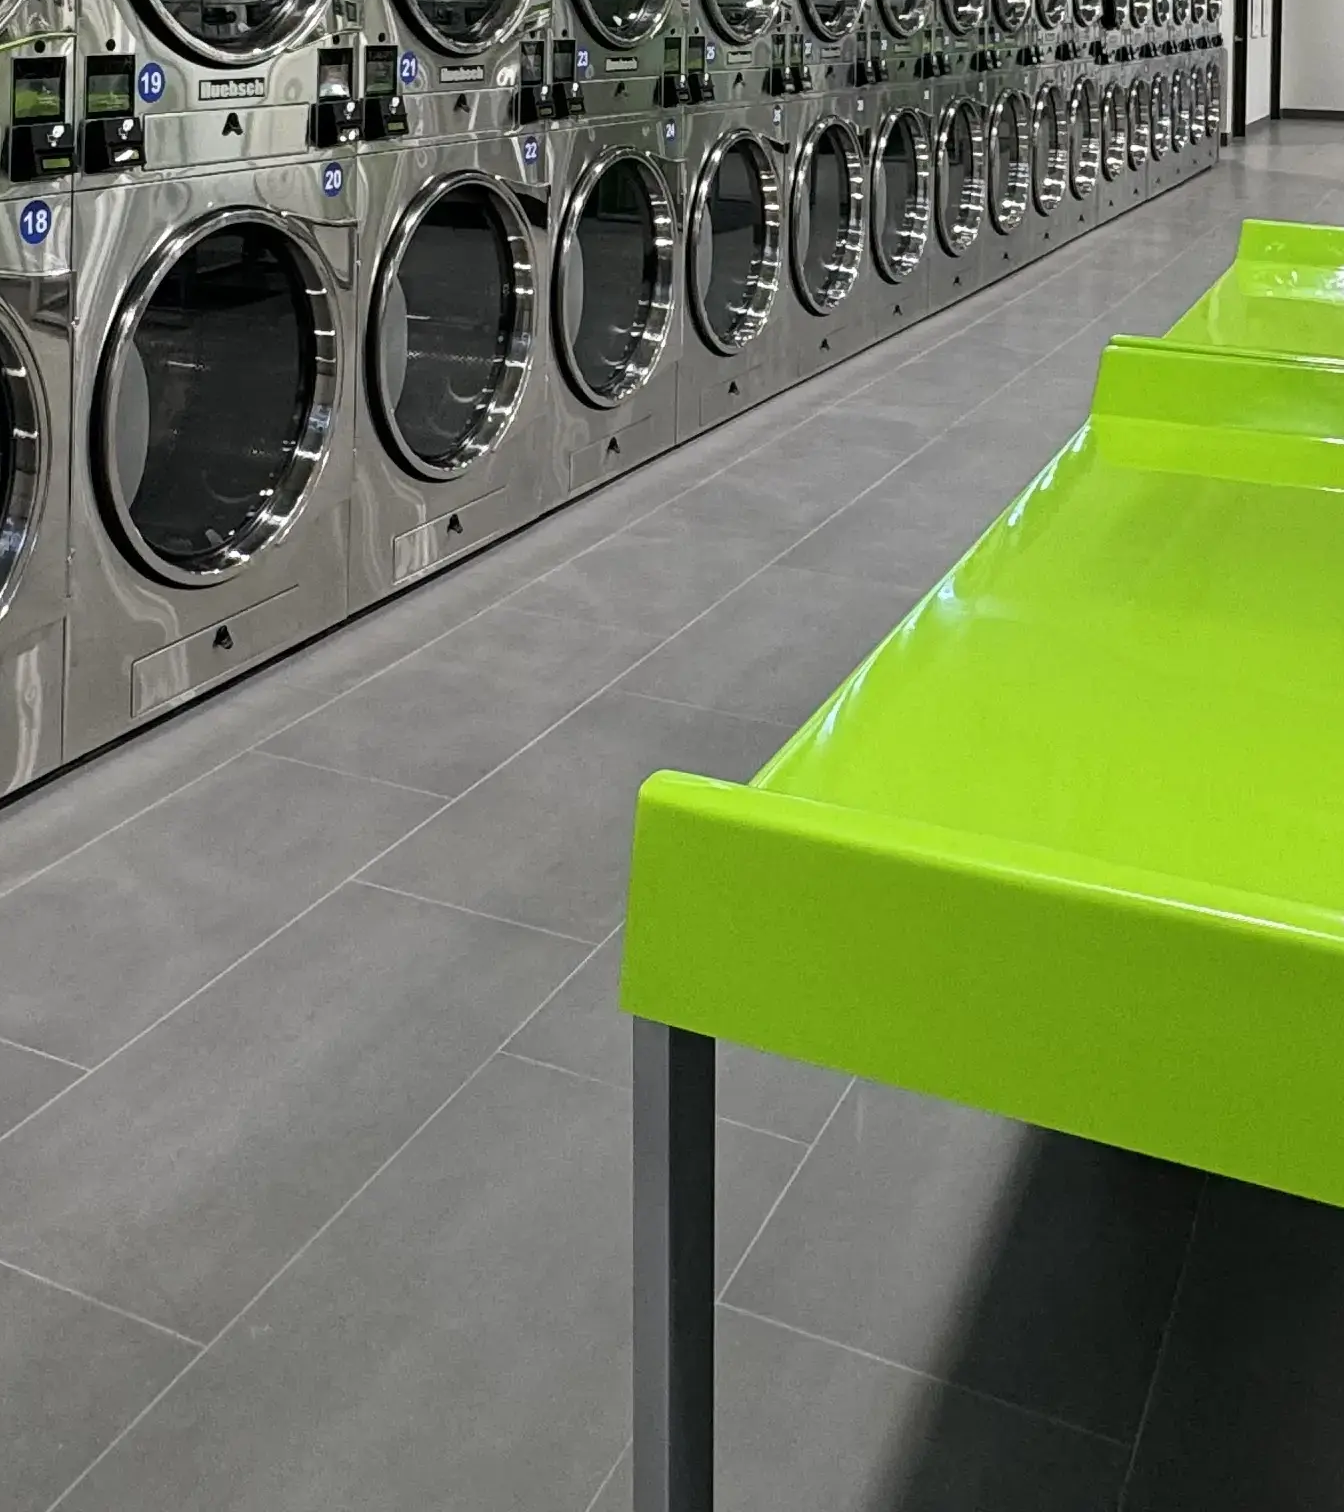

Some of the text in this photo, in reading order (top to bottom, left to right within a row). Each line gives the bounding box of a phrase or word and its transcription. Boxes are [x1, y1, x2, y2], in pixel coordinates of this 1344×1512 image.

[400, 57, 416, 77] 21
[577, 50, 589, 67] 23
[139, 71, 162, 95] 19
[524, 141, 537, 159] 22
[325, 169, 342, 189] 20
[23, 208, 48, 235] 18
